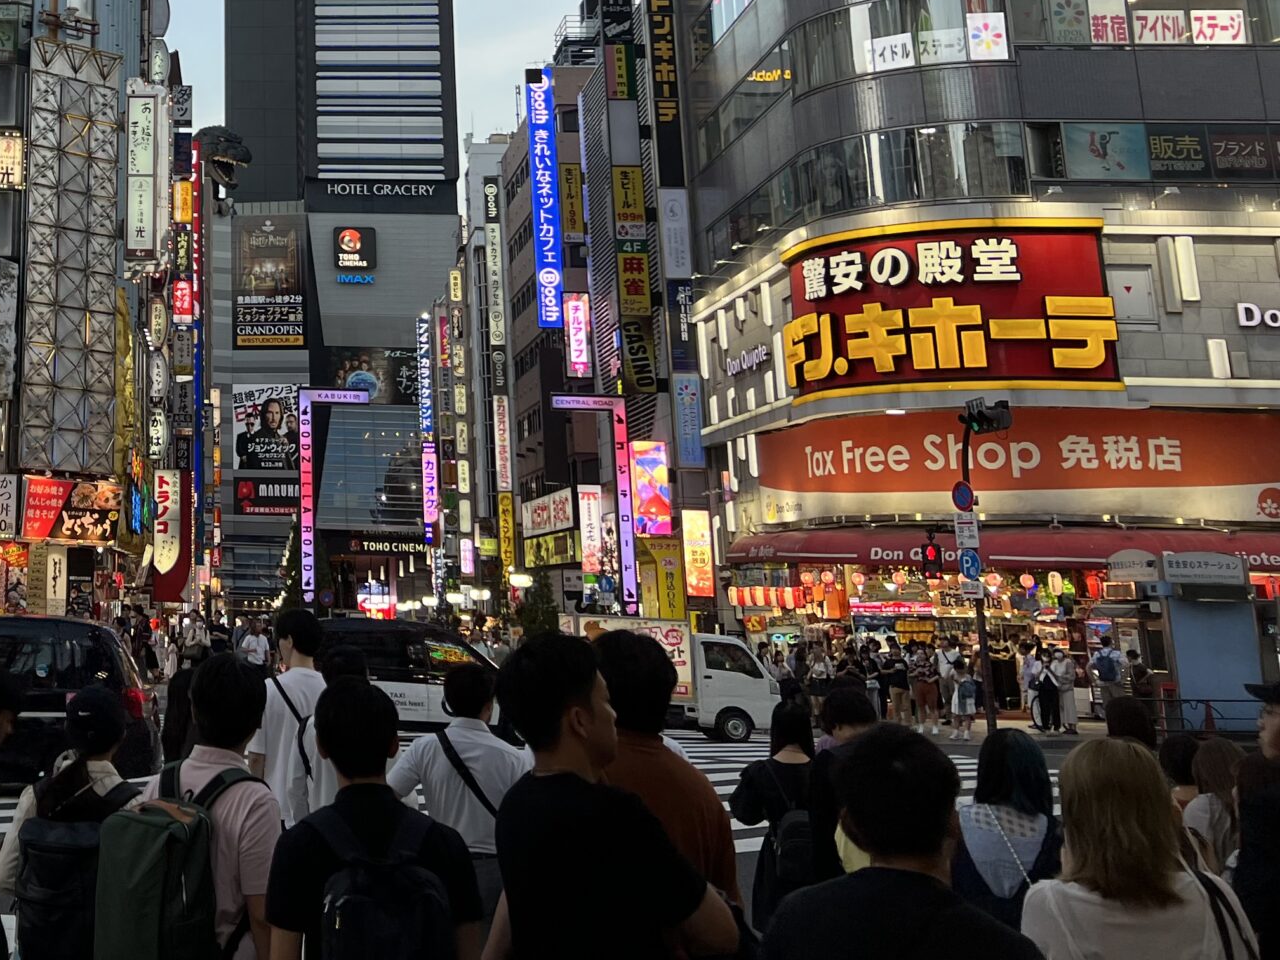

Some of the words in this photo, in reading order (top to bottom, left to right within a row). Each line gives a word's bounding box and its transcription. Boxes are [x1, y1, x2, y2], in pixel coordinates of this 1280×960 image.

[1091, 14, 1128, 43] 新宿
[1136, 16, 1184, 41] アイドル
[1193, 16, 1243, 41] ステージ
[1149, 135, 1202, 159] 販売
[1213, 141, 1266, 156] ブランド
[0, 166, 14, 184] 光
[327, 183, 370, 195] HOTEL
[373, 184, 436, 196] GRACERY
[534, 129, 557, 263] きれいなネットカフェ
[620, 170, 632, 209] 生ビール
[135, 226, 146, 239] 光
[622, 241, 642, 252] 4F
[336, 274, 375, 284] IMAX
[622, 256, 646, 297] 麻雀
[802, 237, 1021, 301] 驚安の殿堂
[539, 268, 561, 322] Booth
[622, 320, 655, 389] CASINO
[726, 357, 740, 376] Don
[301, 419, 313, 514] GODZILLA
[805, 445, 836, 478] Tax
[841, 440, 911, 474] Free
[923, 434, 1041, 479] Shop
[1060, 435, 1182, 472] 免税店
[0, 477, 13, 517] かつ丼
[29, 485, 64, 496] お好み焼き
[424, 460, 436, 509] カラオケ
[27, 509, 56, 519] 焼きそば
[157, 475, 170, 535] トラノコ
[302, 526, 312, 573] ROAD
[363, 542, 389, 551] TOHO
[649, 543, 679, 551] カラオケ
[870, 547, 903, 560] Don
